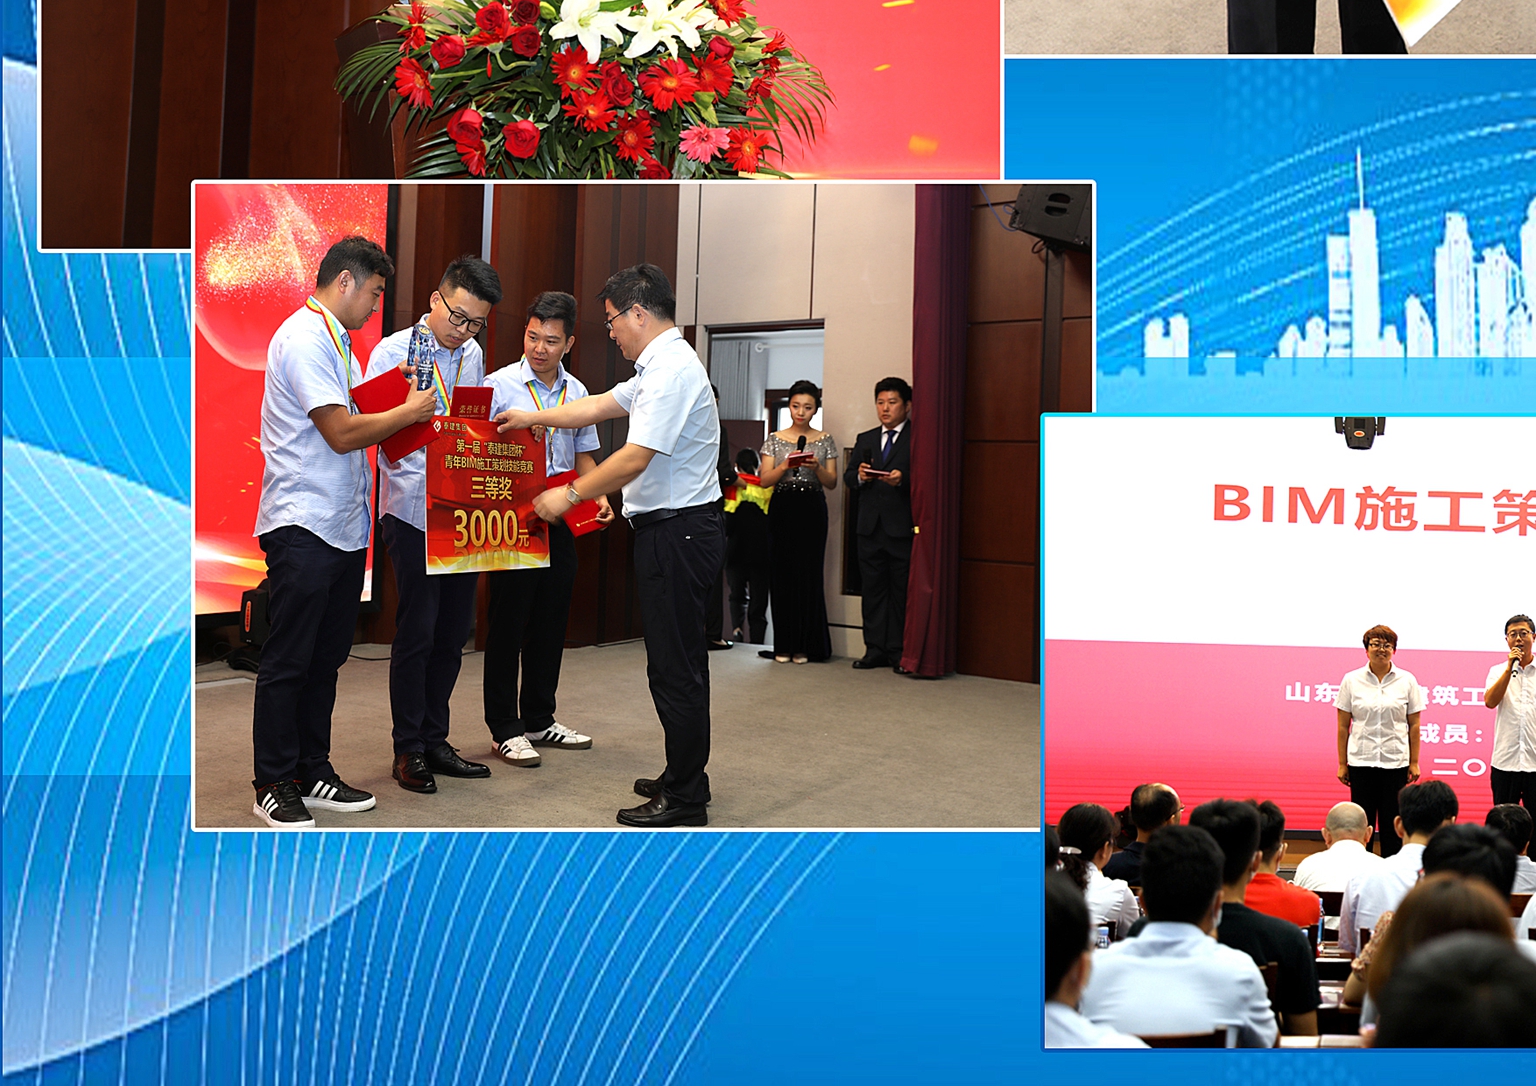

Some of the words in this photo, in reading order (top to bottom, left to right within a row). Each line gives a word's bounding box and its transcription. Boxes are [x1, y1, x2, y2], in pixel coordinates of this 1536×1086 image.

[456, 438, 481, 455] 第一届
[444, 454, 534, 474] 青年BIM施工策划技能竞赛
[470, 475, 513, 501] 三等奖
